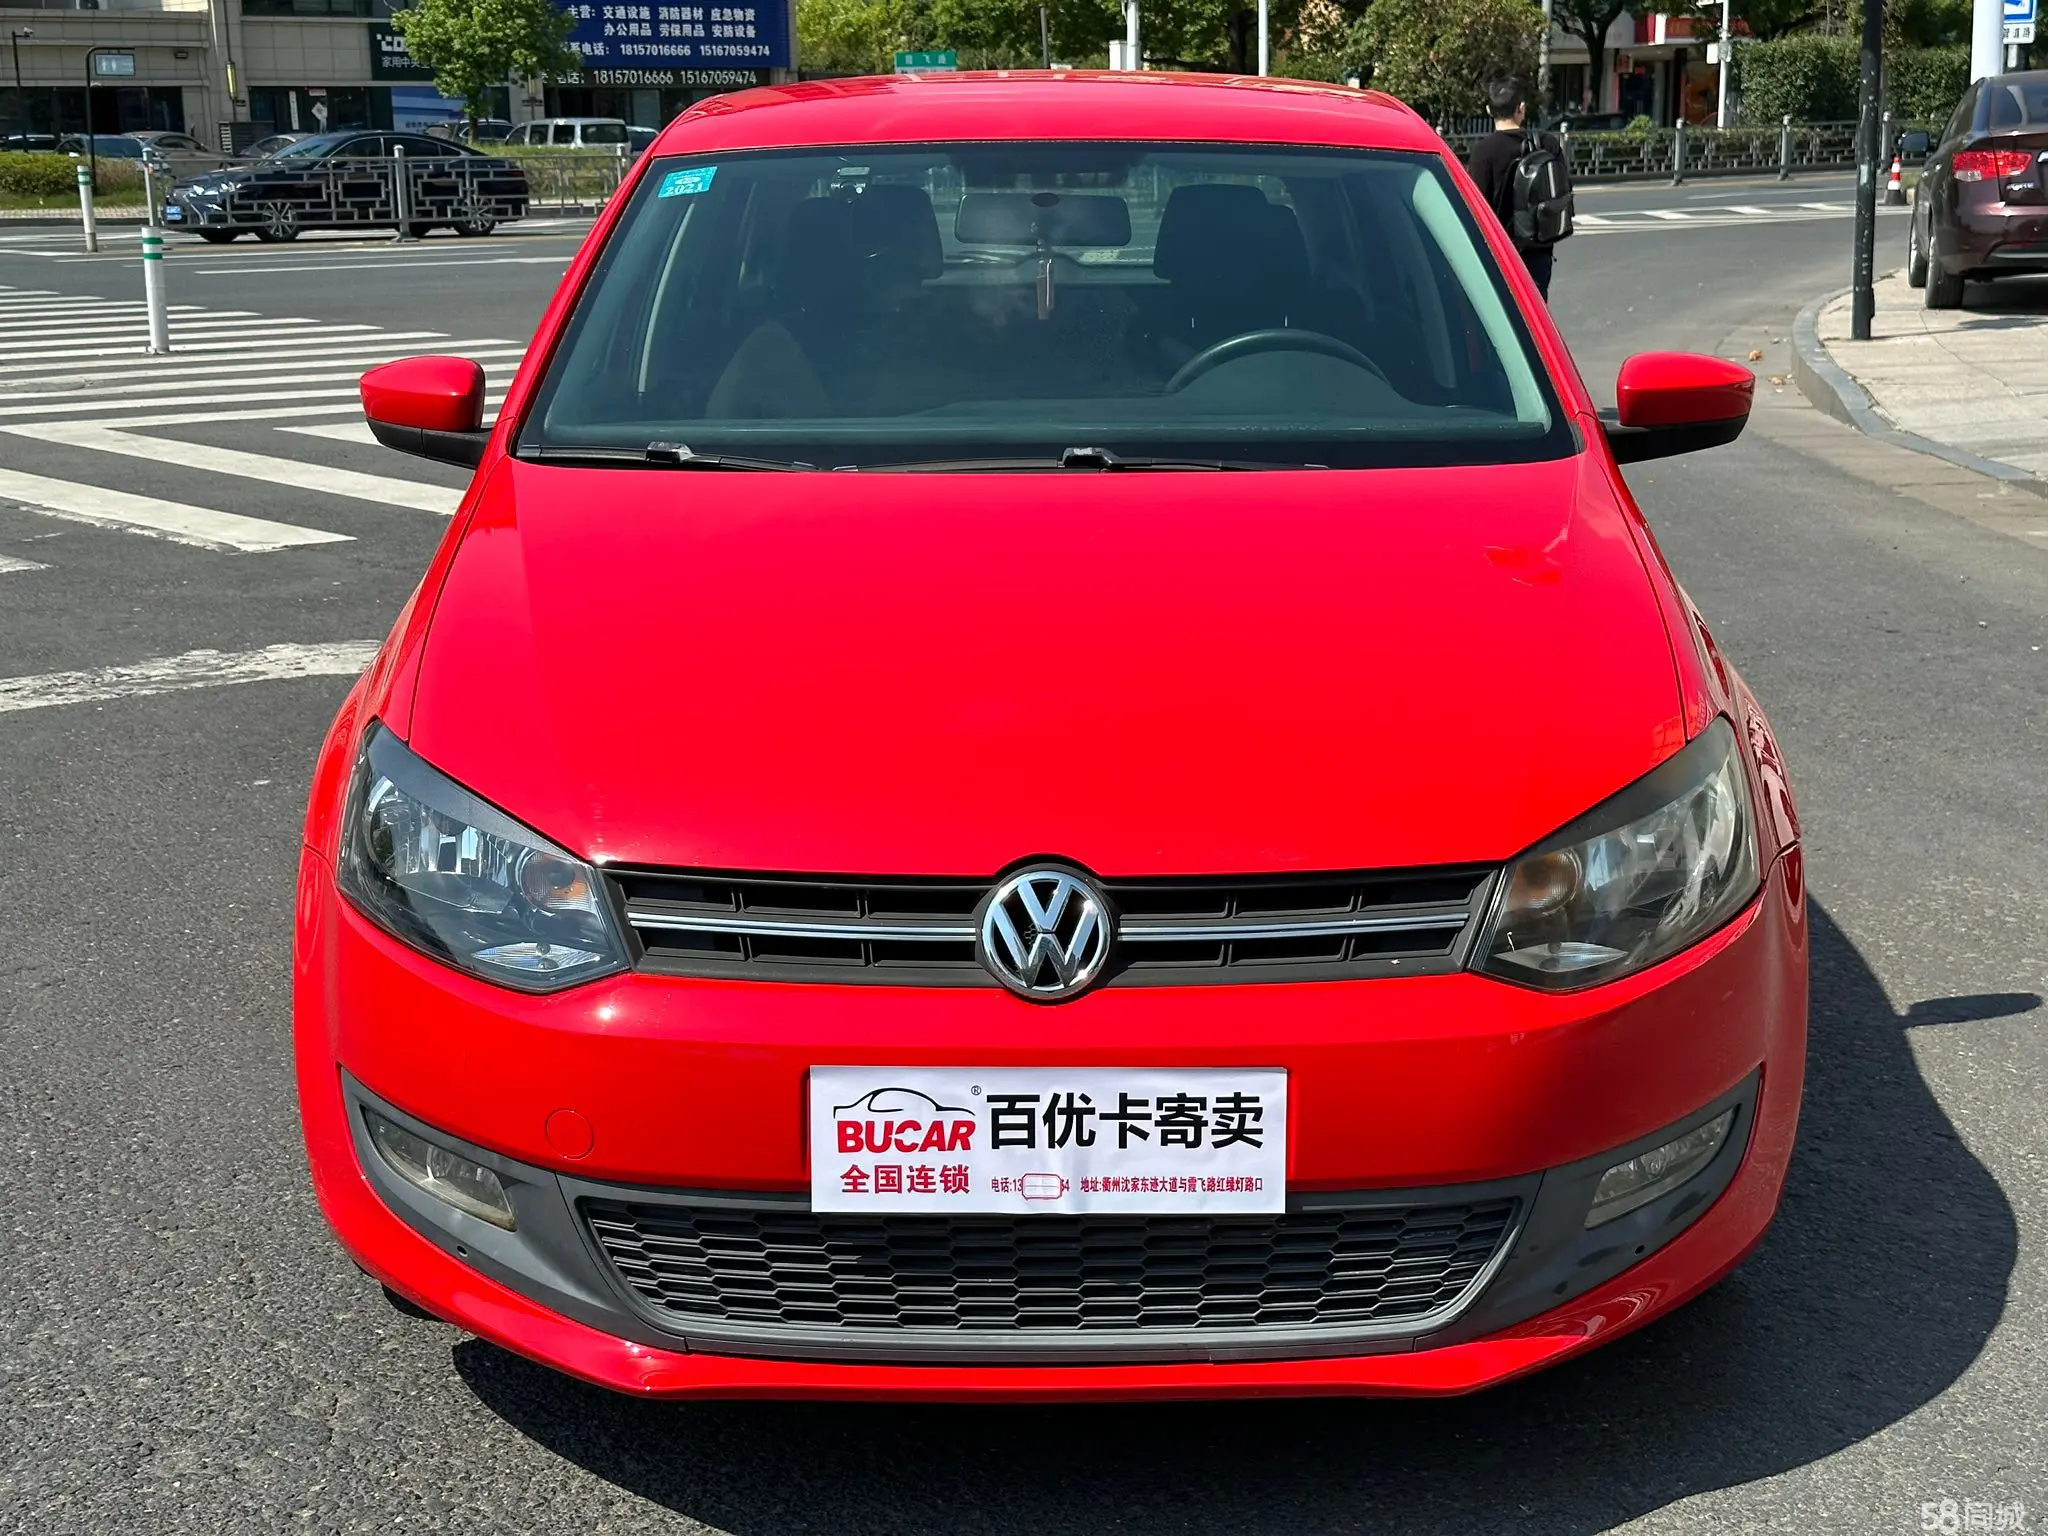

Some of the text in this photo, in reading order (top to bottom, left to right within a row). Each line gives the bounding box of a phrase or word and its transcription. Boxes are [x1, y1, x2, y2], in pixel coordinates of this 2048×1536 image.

[602, 5, 651, 20] 交通设施
[658, 6, 704, 20] 消防器材
[711, 7, 755, 21] 应急物资
[603, 22, 756, 38] 办公用品 劳保用品 安防设备
[620, 44, 691, 56] 18157016666
[700, 45, 770, 56] 15167059474
[381, 56, 430, 68] 家用中央
[593, 70, 673, 84] 18157016666
[680, 70, 757, 84] 15167059474
[666, 182, 704, 195] 2021
[986, 1092, 1264, 1150] 百优卡寄卖
[837, 1119, 976, 1153] BUCAR
[840, 1164, 970, 1194] 全国连锁
